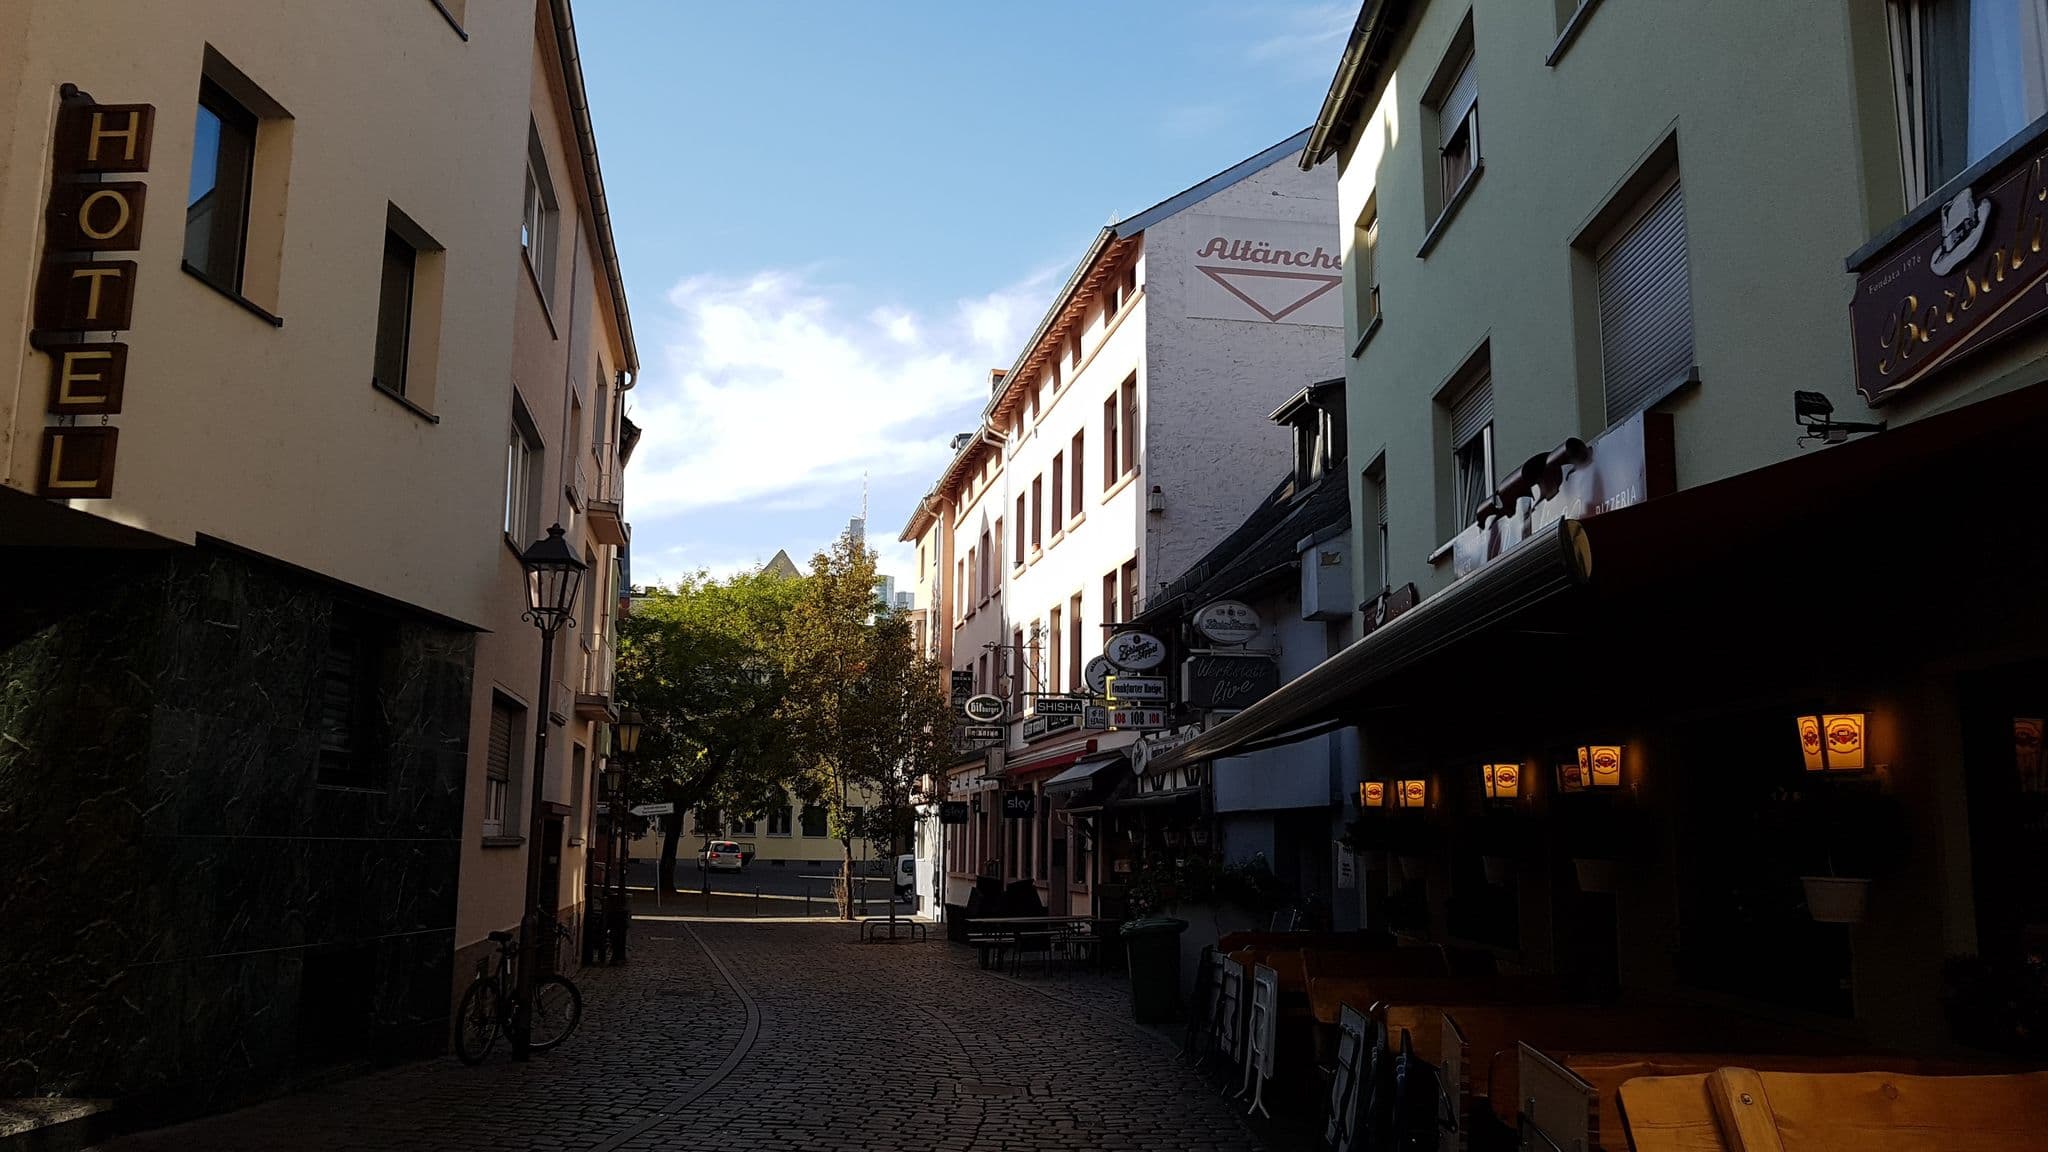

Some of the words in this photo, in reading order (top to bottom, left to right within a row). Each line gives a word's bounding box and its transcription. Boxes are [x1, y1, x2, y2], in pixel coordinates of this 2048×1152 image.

[47, 111, 140, 489] HOTEL
[1039, 702, 1081, 712] SHISHA
[1130, 711, 1145, 725] 108
[1007, 794, 1031, 811] sky
